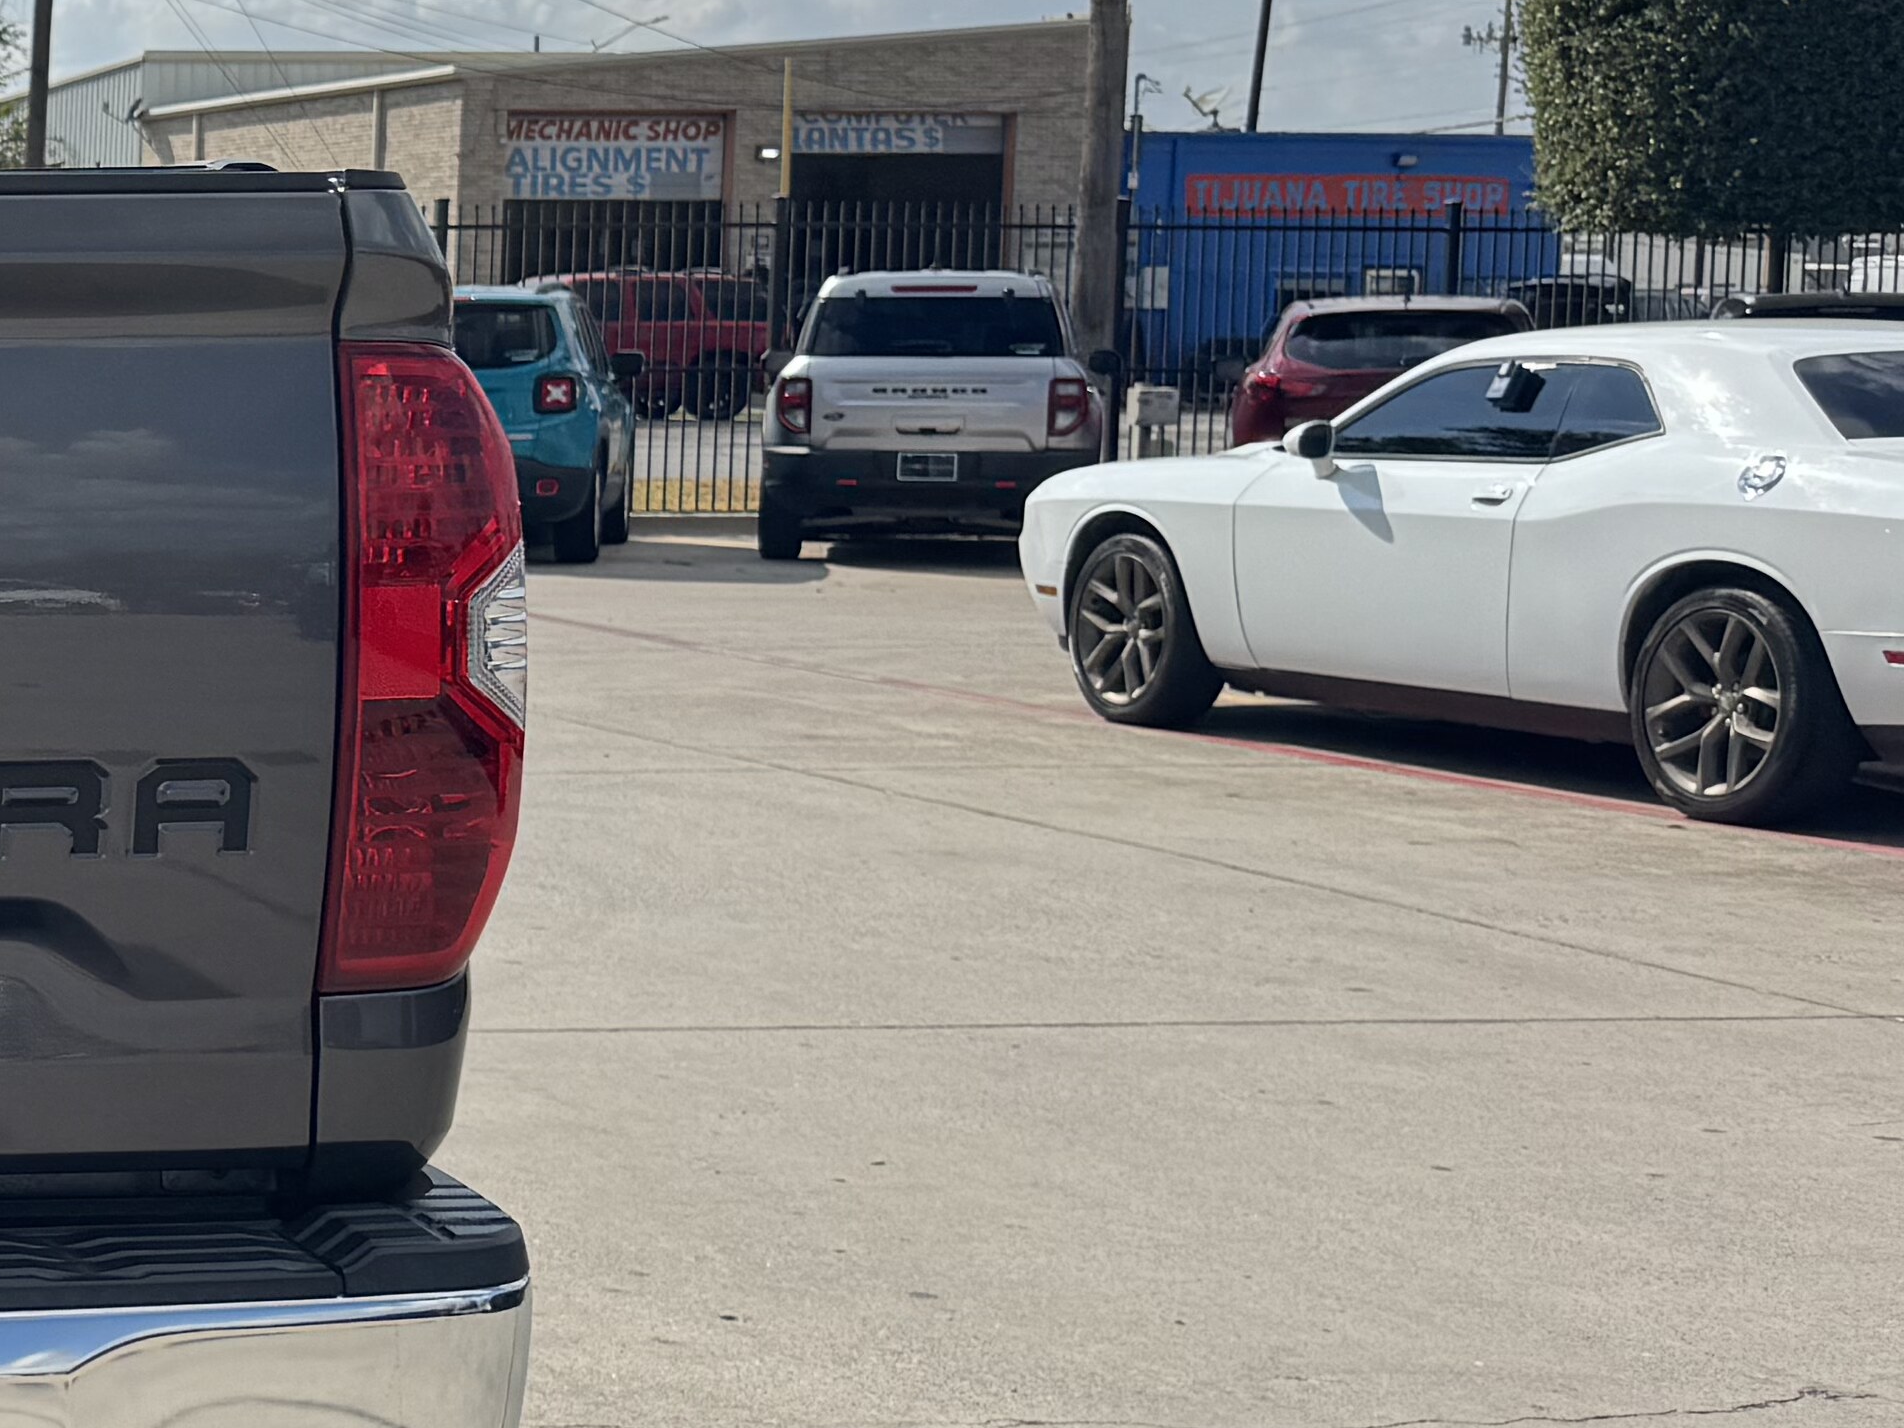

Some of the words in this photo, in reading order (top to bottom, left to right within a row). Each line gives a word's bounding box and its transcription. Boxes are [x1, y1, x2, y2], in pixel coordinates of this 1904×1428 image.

[646, 119, 722, 142] SHOP
[505, 146, 710, 173] ALIGNMENT
[511, 173, 613, 196] TIRES
[626, 170, 647, 197] $
[1193, 180, 1330, 210] TIJUANA
[1344, 180, 1408, 210] TIRE
[1423, 180, 1505, 210] SHOP
